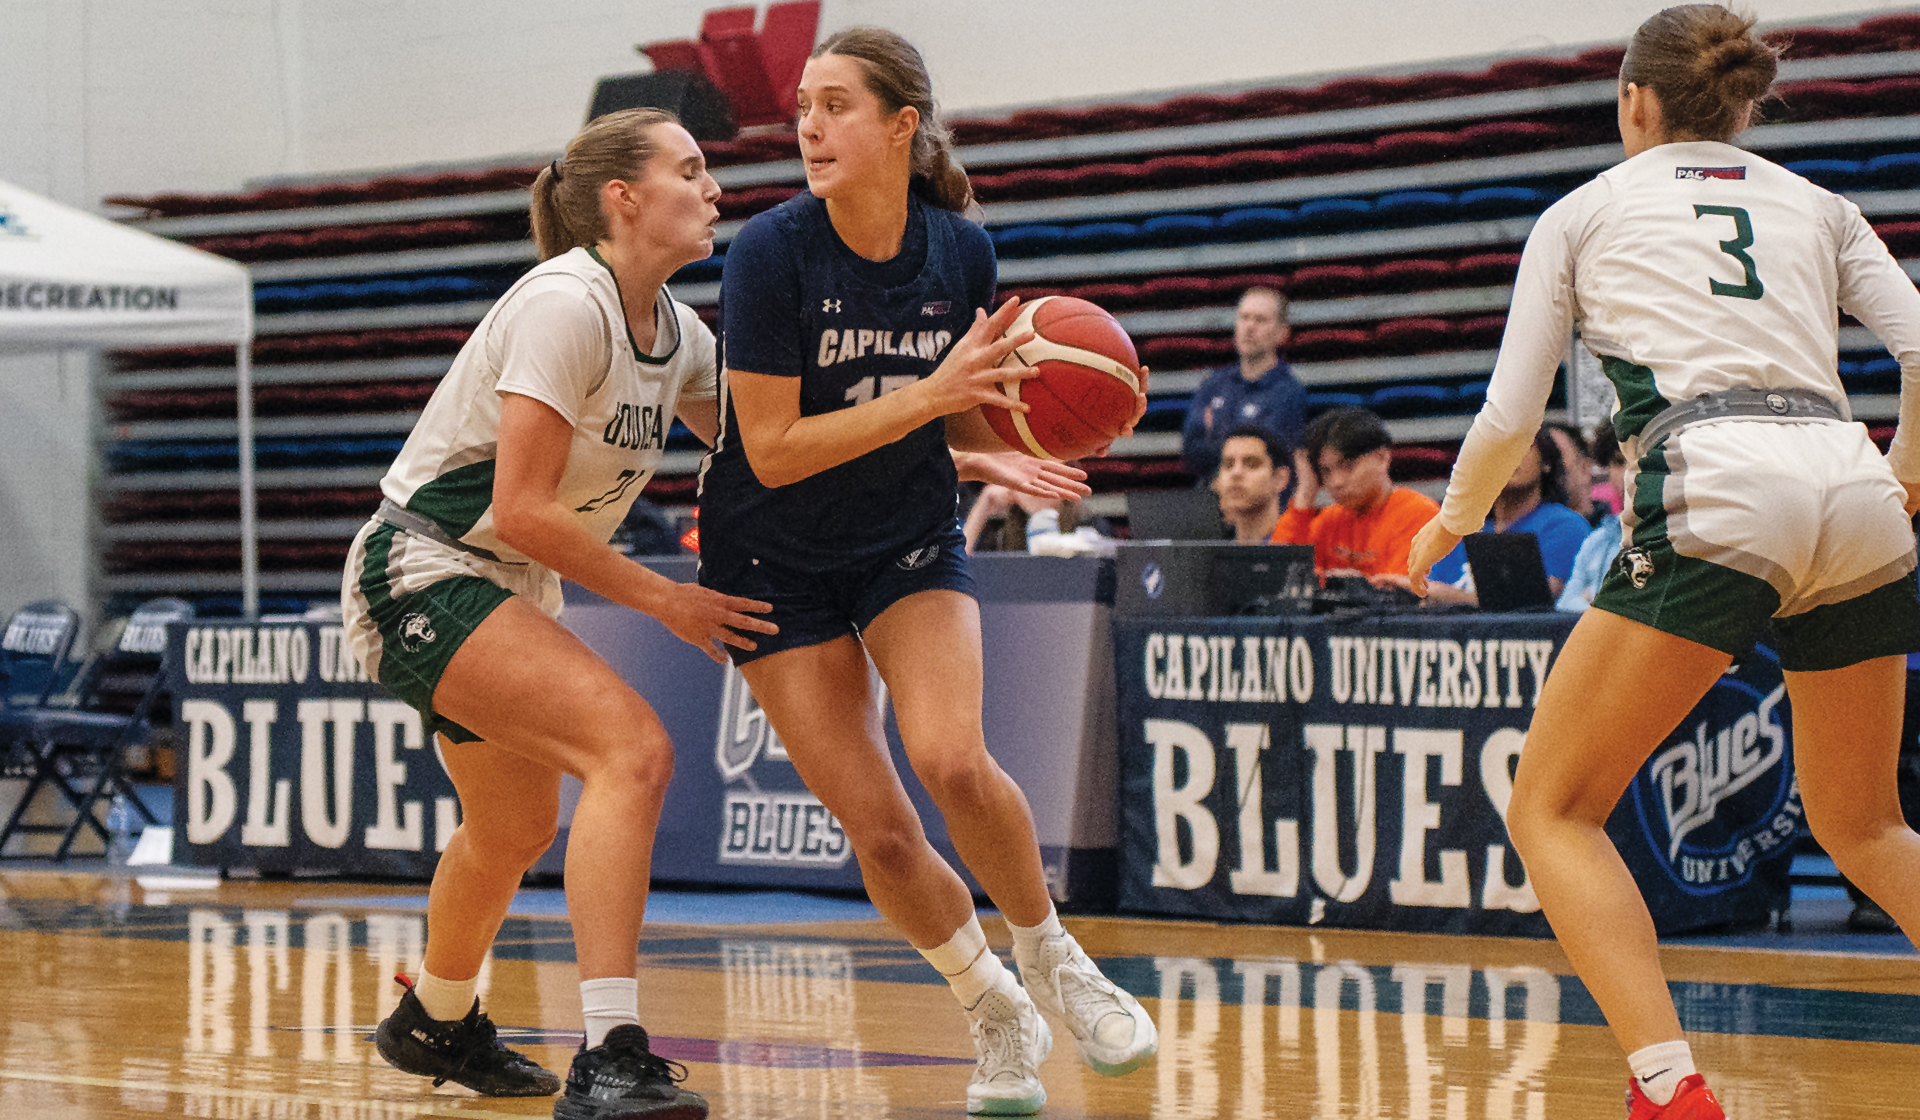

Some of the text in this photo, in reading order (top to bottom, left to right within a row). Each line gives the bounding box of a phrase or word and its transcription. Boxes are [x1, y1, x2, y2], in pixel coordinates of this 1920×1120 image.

[1693, 204, 1764, 300] 3
[0, 284, 179, 309] ECREATION
[818, 329, 952, 368] CAPILANO
[844, 375, 919, 406] 1
[185, 627, 310, 684] CAPILANO
[1145, 633, 1553, 708] CAPILANO UNIVERSITY
[181, 700, 461, 853] BLUE
[727, 802, 846, 856] BLUES
